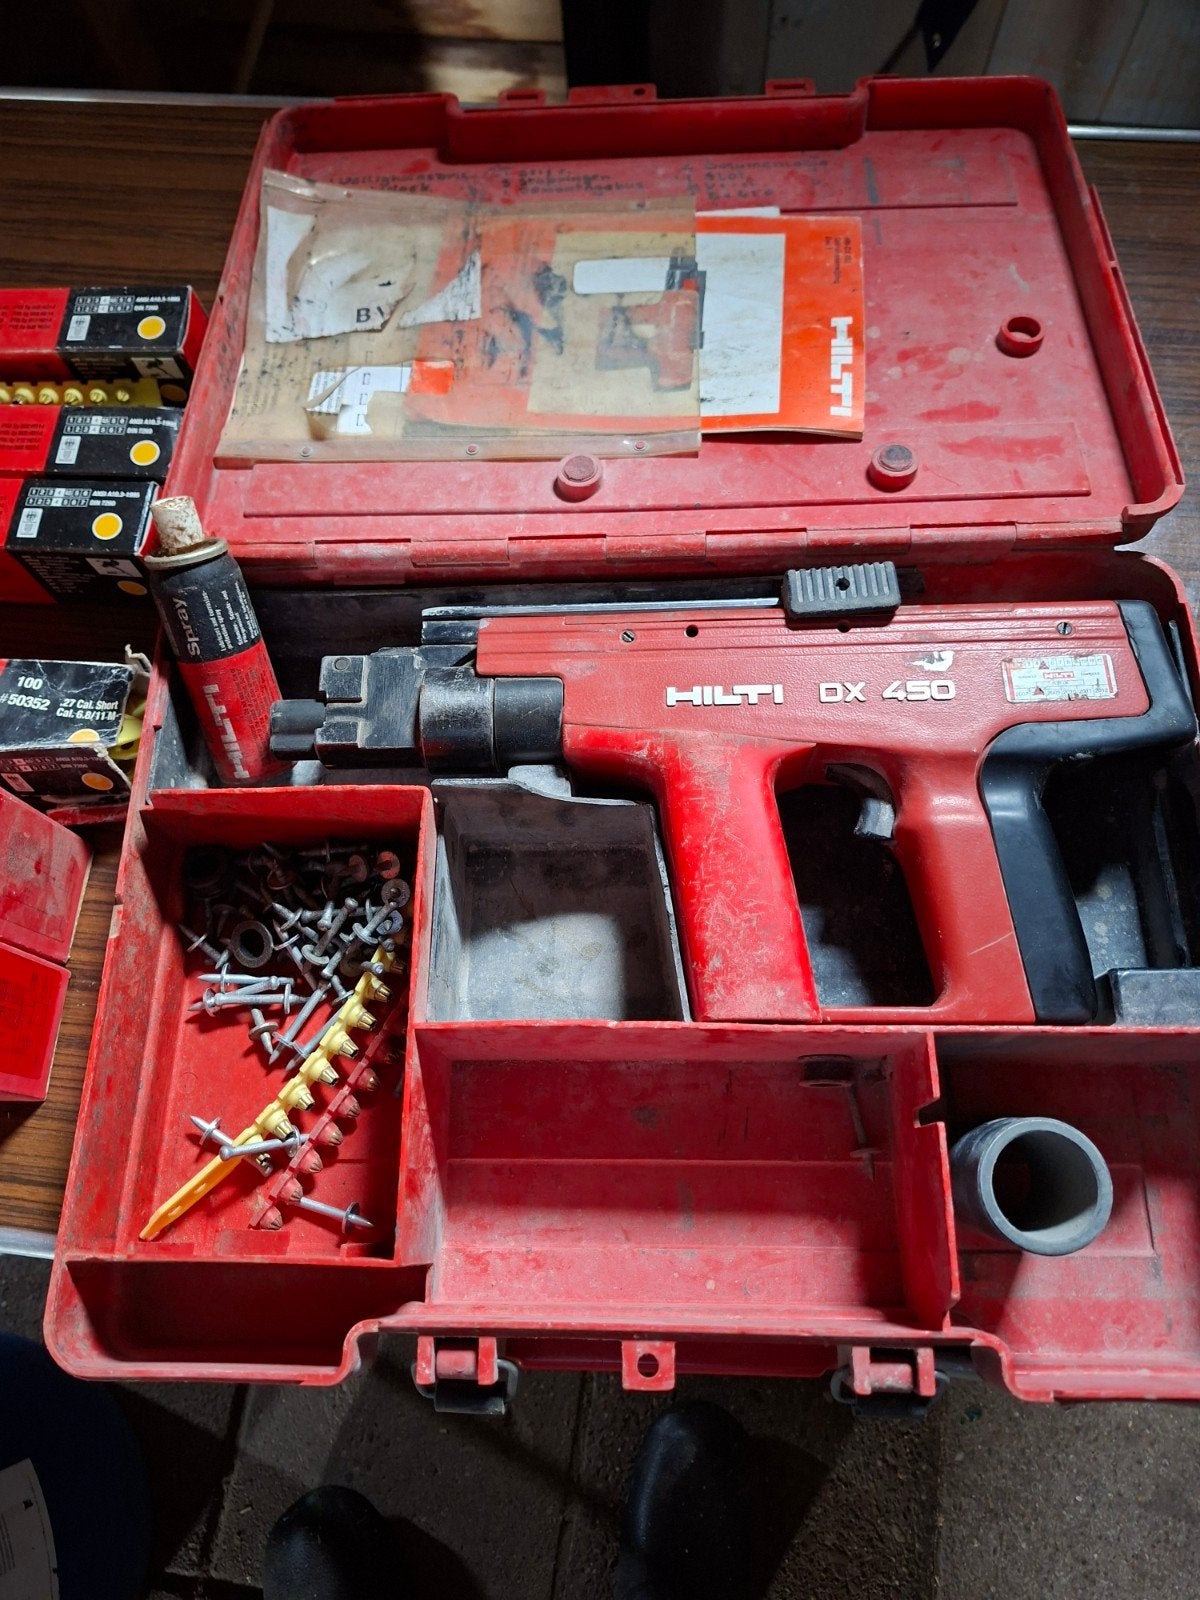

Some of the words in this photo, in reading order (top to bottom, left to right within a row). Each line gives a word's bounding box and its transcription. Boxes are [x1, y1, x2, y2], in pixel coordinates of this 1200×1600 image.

[830, 316, 853, 417] HILTI
[172, 597, 200, 656] Spray
[17, 675, 43, 690] 100
[666, 684, 784, 706] HILTI
[819, 682, 867, 703] DX
[882, 679, 956, 703] 450
[0, 693, 51, 711] #50352
[60, 698, 76, 708] .27
[77, 699, 94, 710] Cal.
[96, 700, 118, 710] Short
[56, 708, 74, 718] Cal.
[202, 684, 251, 779] HILTI
